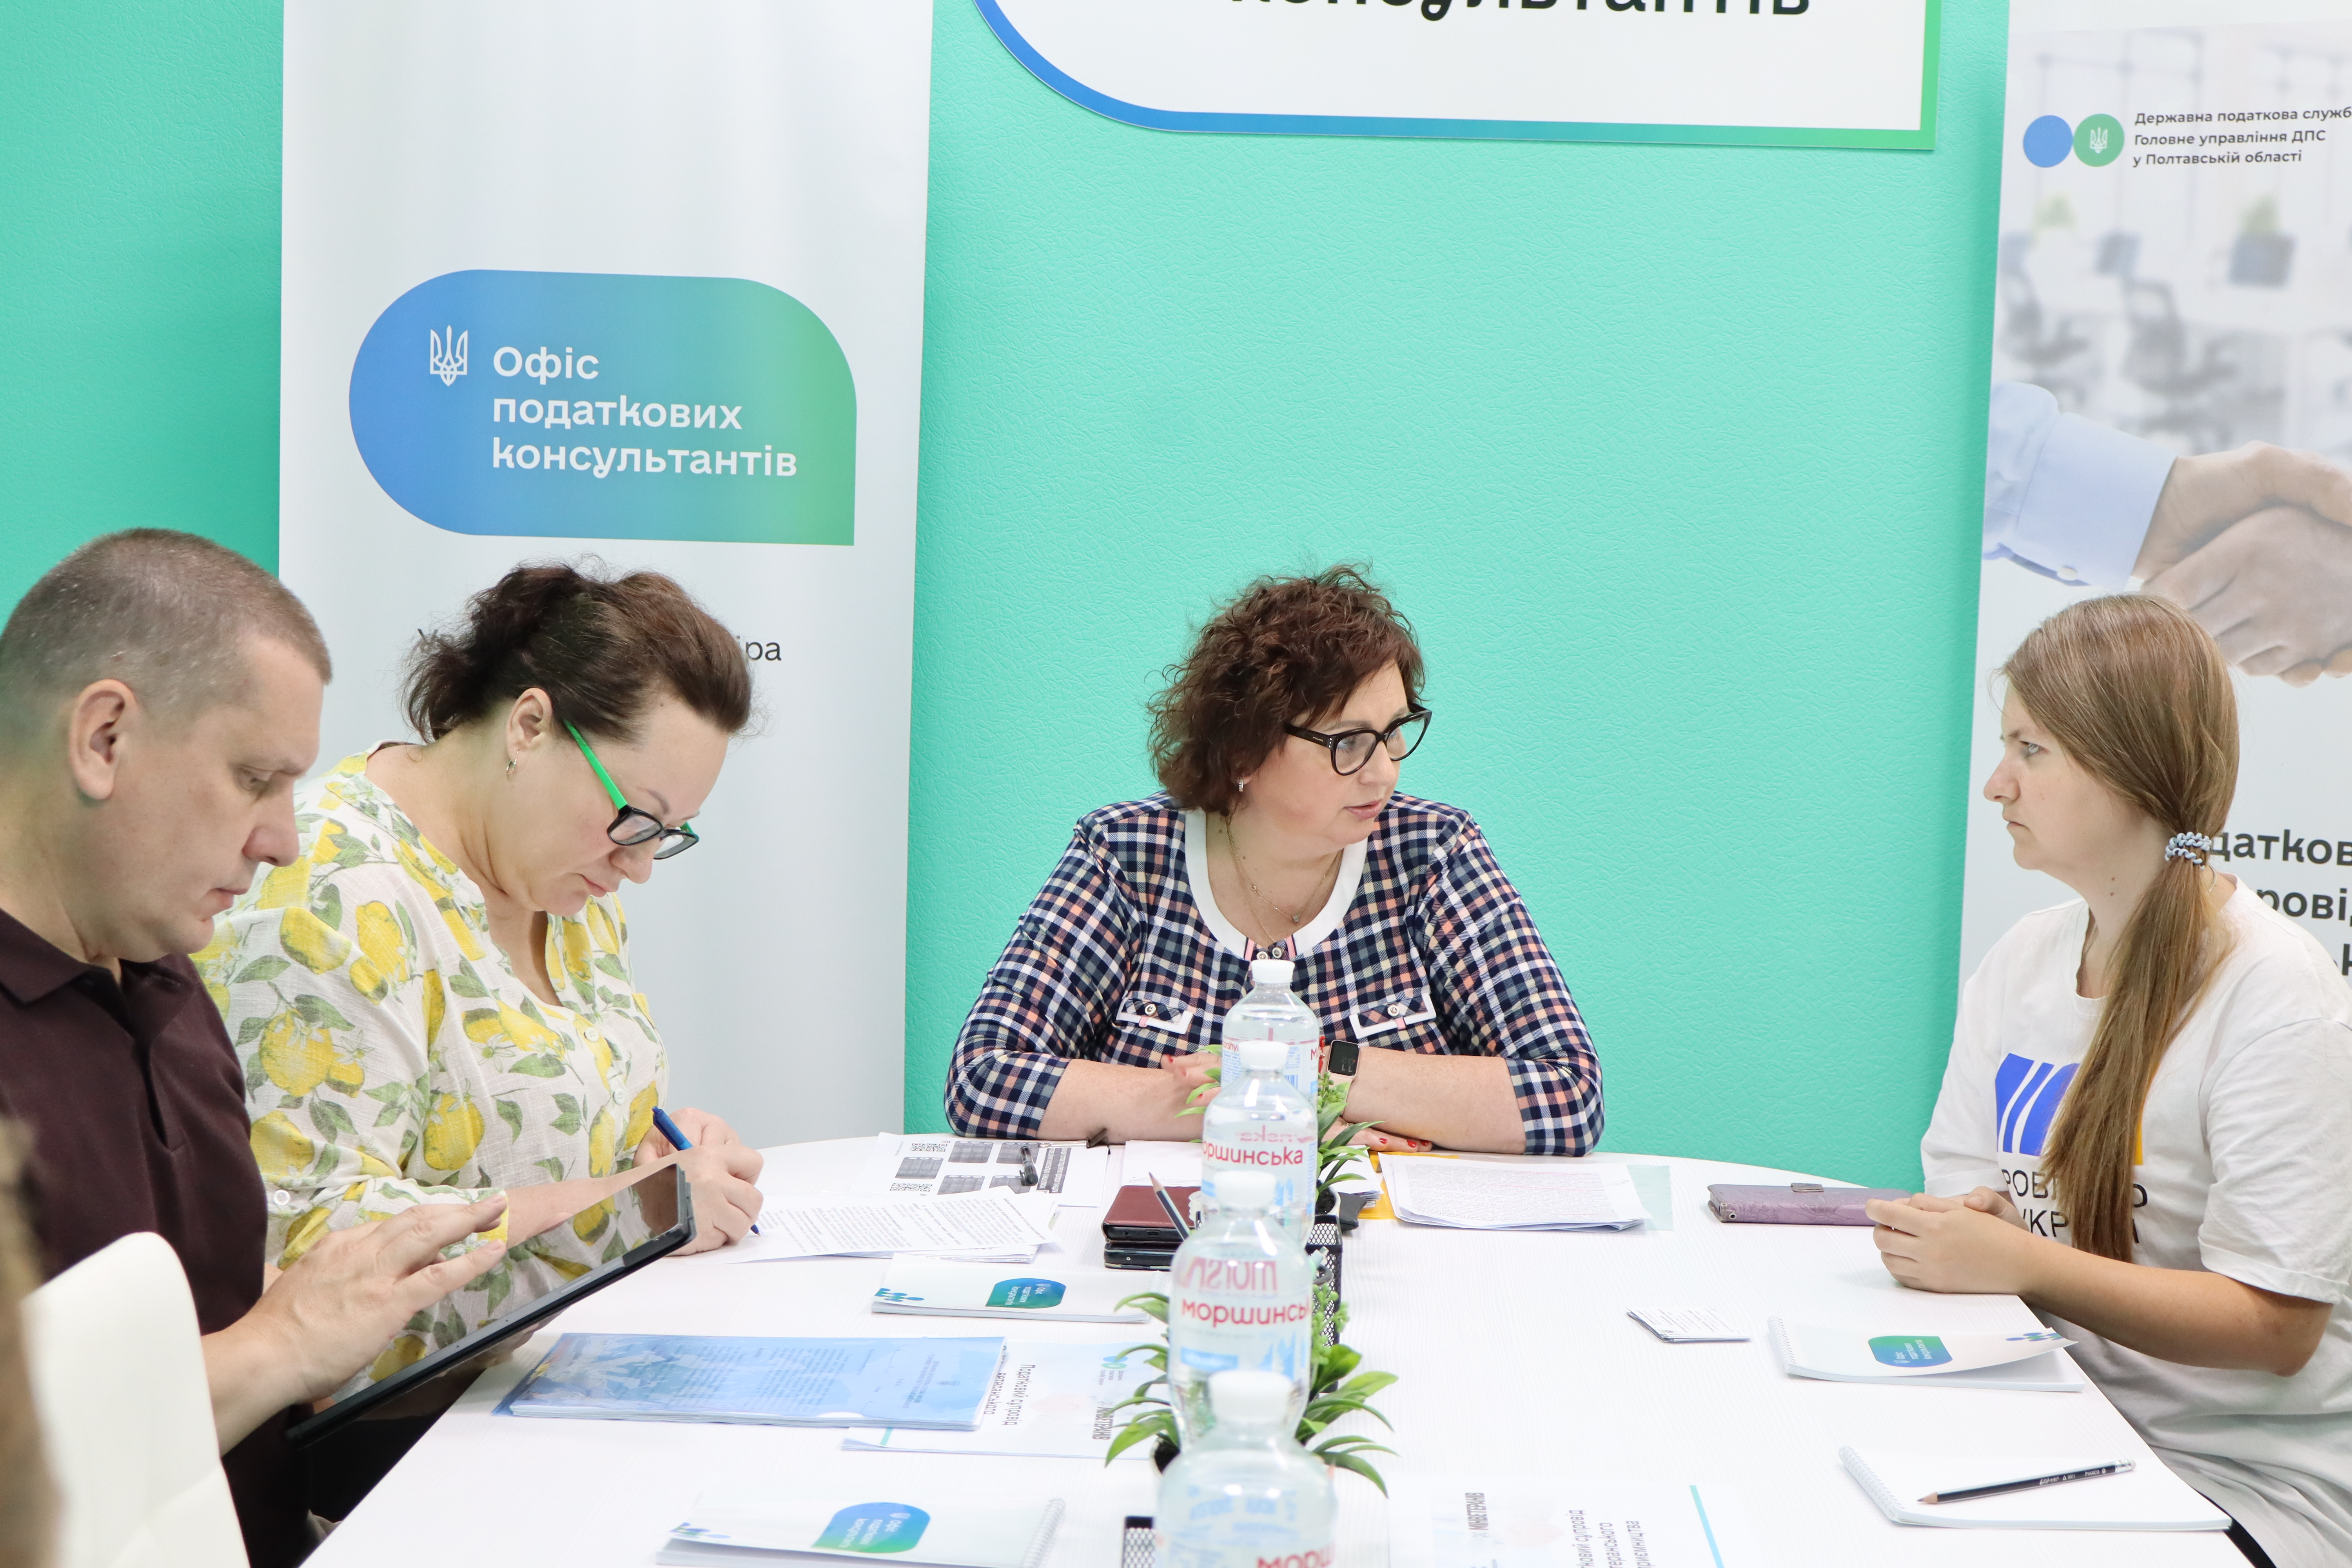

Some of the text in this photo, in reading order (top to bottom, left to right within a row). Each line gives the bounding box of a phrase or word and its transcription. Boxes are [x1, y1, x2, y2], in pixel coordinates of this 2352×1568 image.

[2135, 113, 2212, 126] Державна
[2218, 111, 2298, 123] податкова
[2134, 130, 2326, 147] Головне управління ДПС
[2132, 150, 2302, 167] у Полтавській області
[492, 345, 600, 385] Офіс
[493, 394, 742, 429] податкових
[492, 436, 798, 479] консультантів
[1001, 1365, 1036, 1426] Податковий супровід
[1465, 1492, 1490, 1530] МІНВЕТЕРАНІВ
[1565, 1510, 1593, 1542] супровід
